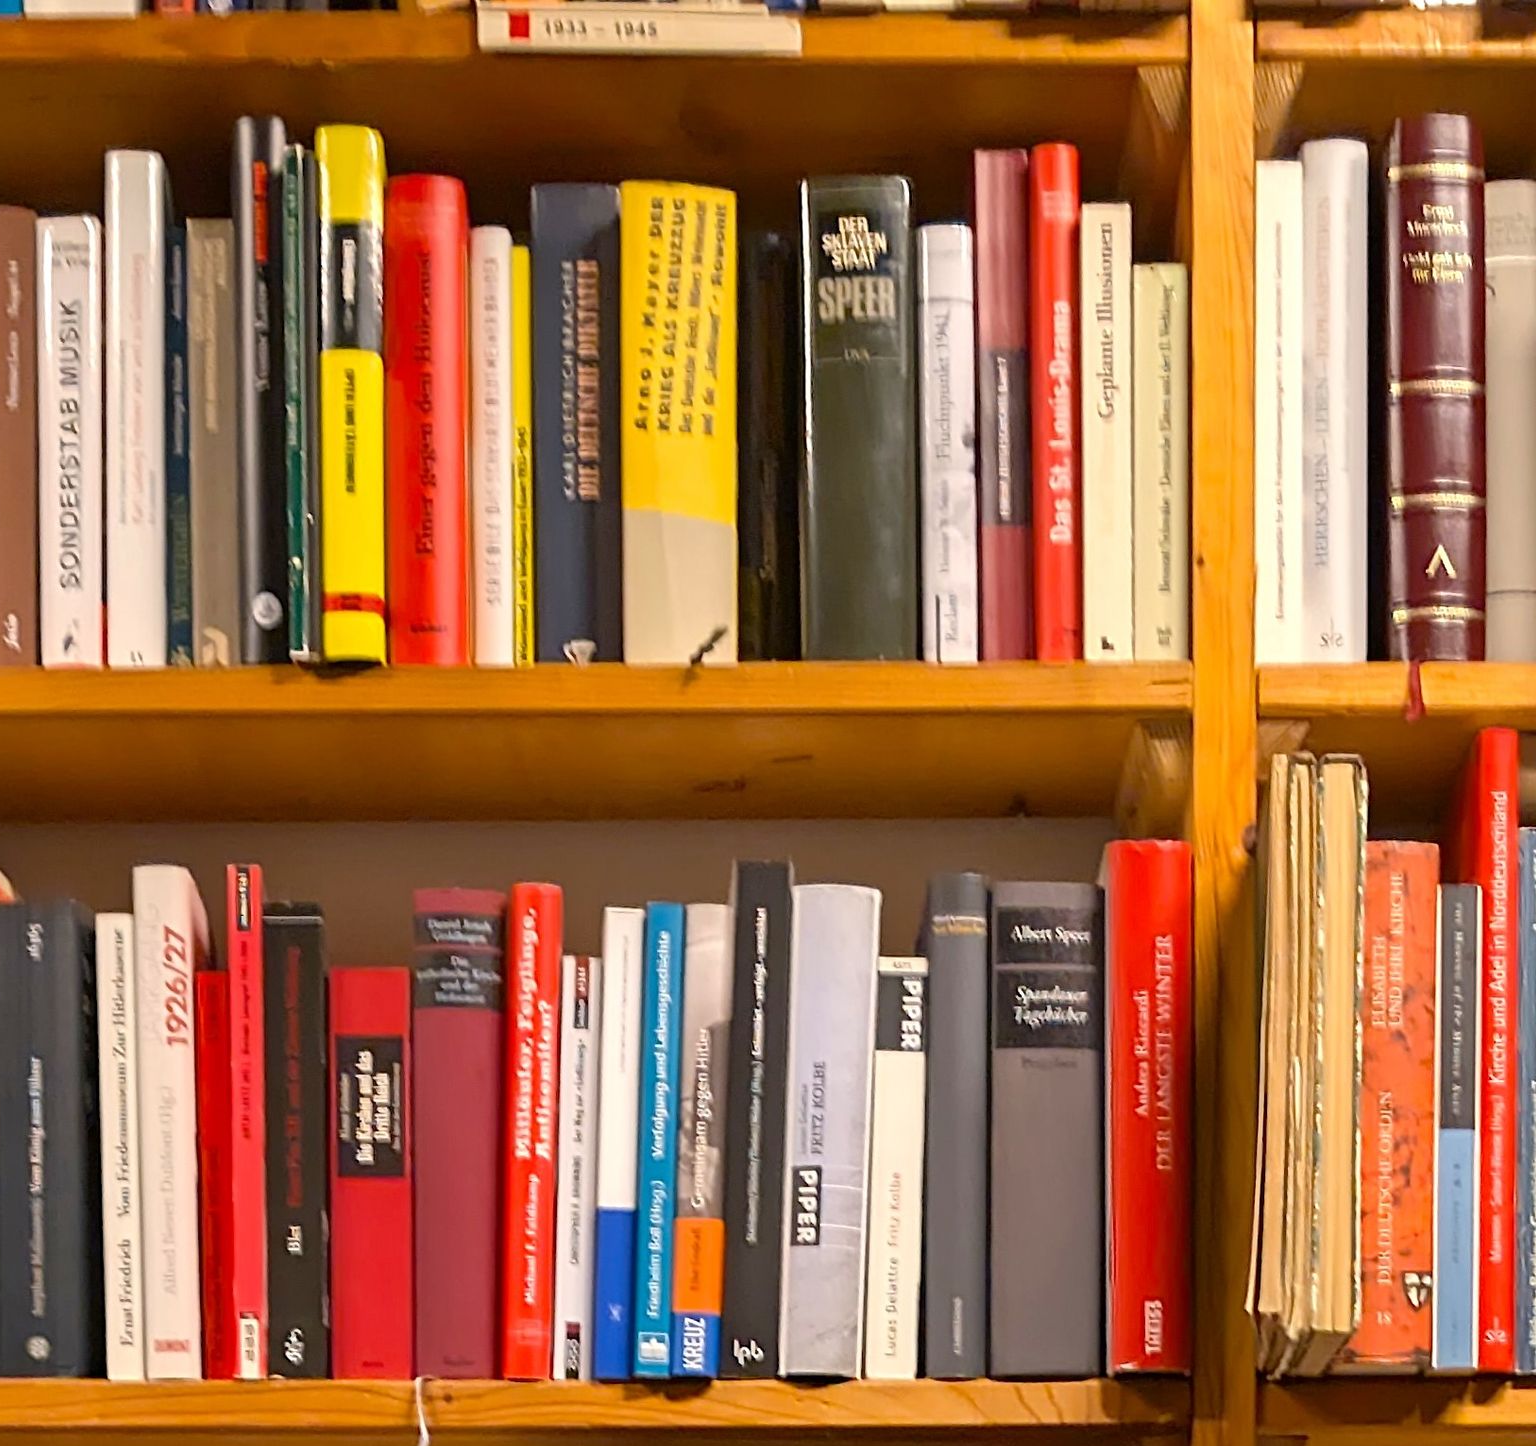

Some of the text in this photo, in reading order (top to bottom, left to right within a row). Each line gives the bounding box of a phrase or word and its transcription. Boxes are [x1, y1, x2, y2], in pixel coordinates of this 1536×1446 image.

[544, 20, 657, 37] 1933 1945
[1048, 301, 1072, 449] Louis-Drama
[58, 300, 79, 589] SONDERSTAB MUSIK
[1050, 498, 1073, 544] Das
[1488, 791, 1509, 1084] Kirche und Adel in Norddeutschland
[162, 924, 189, 1047] 1926/27
[899, 978, 922, 1049] PIPER
[693, 1028, 710, 1069] Hitler
[693, 1074, 714, 1118] gegen
[689, 1123, 711, 1208] Gemeinsam
[796, 1168, 819, 1242] PIPER
[682, 1318, 706, 1369] KREUZ
